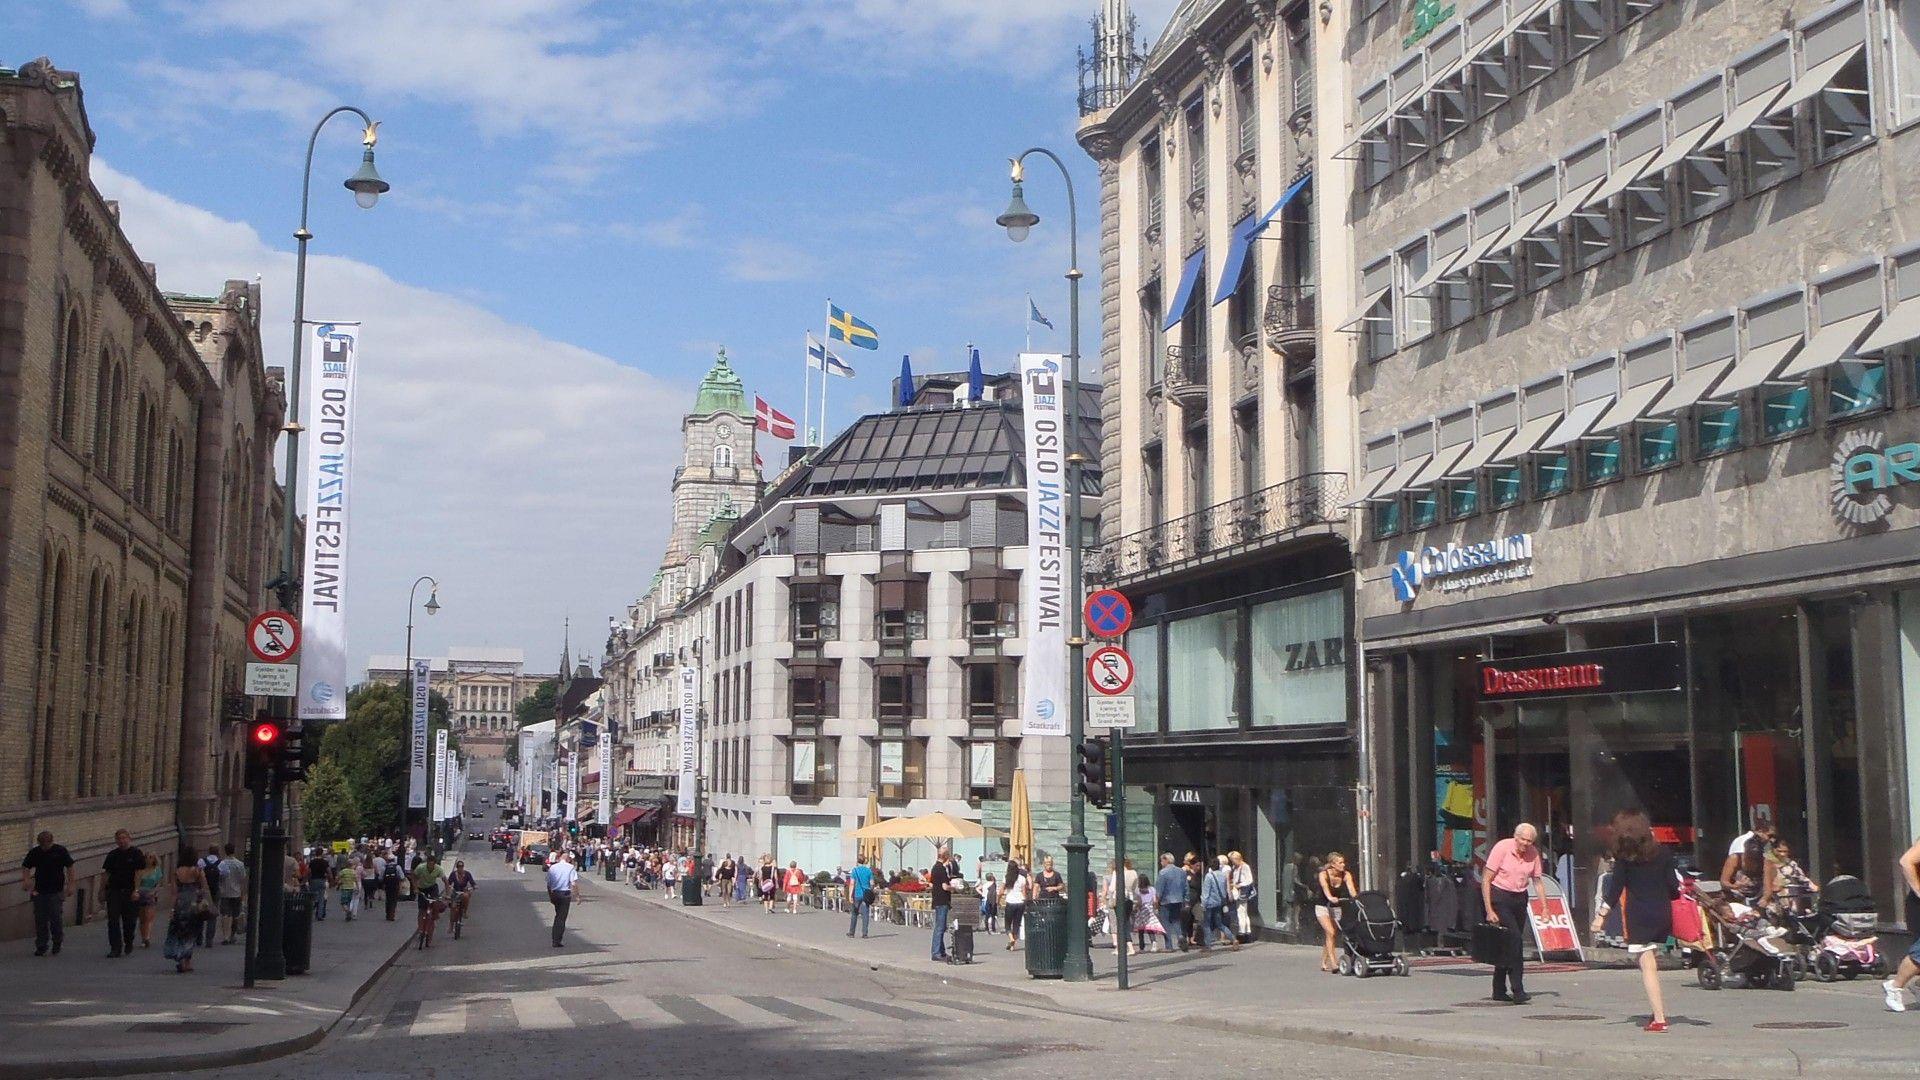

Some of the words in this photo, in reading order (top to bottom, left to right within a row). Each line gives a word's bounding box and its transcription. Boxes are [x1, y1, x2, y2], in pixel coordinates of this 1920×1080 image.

[1034, 419, 1059, 474] OSLO
[1038, 479, 1061, 632] JAZZFESTIVAL
[1421, 533, 1532, 576] Colosseum
[1483, 664, 1604, 695] Dressmann
[683, 692, 694, 715] OSLO
[1028, 721, 1060, 730] Statkraft
[683, 716, 694, 775] JAZZFESTIVAL
[1172, 789, 1201, 803] ZARA
